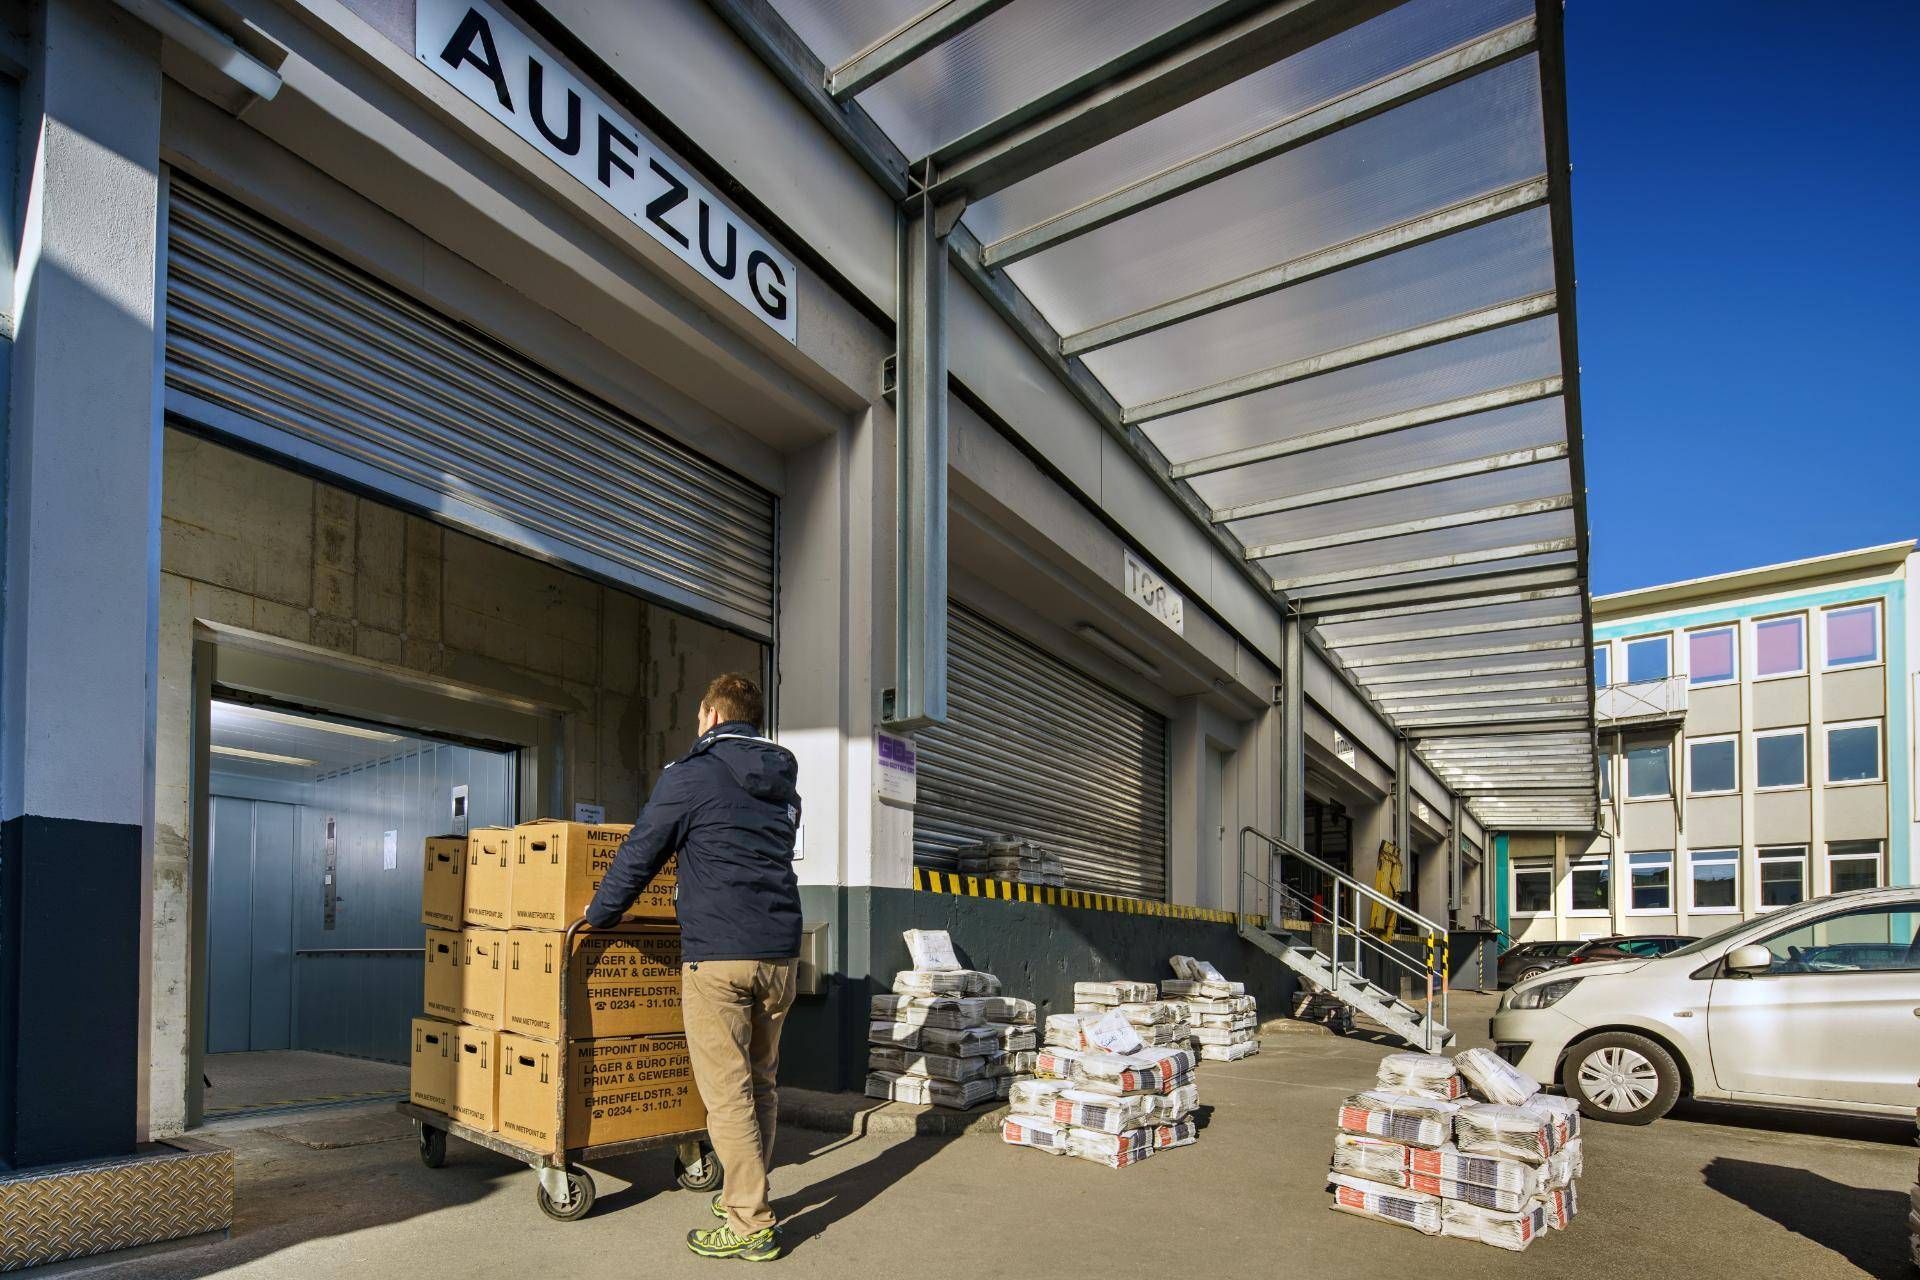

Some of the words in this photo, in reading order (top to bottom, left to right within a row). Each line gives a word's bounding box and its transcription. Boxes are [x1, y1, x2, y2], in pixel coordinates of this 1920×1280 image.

[440, 6, 787, 320] AUFZUG
[651, 897, 675, 906] 31.1
[580, 939, 641, 949] MIETPOINT
[643, 940, 654, 948] IN
[657, 940, 681, 949] BOC
[586, 955, 626, 966] LAGER
[629, 956, 637, 965] &
[640, 953, 671, 965] BÜRO
[586, 968, 628, 978] PRIVAT
[631, 968, 639, 977] &
[587, 986, 679, 998] EHRENFELDSTR.
[610, 1000, 635, 1010] 0234
[578, 1044, 637, 1058] MIETPOINT
[640, 1043, 650, 1053] IN
[653, 1041, 689, 1051] BOCHU
[584, 1062, 622, 1075] LAGER
[625, 1061, 633, 1071] &
[636, 1056, 668, 1069] BÜRO
[669, 1055, 690, 1066] FÜR
[584, 1074, 625, 1088] PRIVAT
[627, 1073, 635, 1083] &
[638, 1067, 689, 1081] GEWERBE
[584, 1088, 674, 1107] EHRENFELDSTR.
[677, 1086, 689, 1095] 34
[607, 1106, 632, 1117] 0234
[642, 1099, 682, 1112] 31.10.71
[503, 1120, 547, 1139] WWW.MIETPOINT.DE
